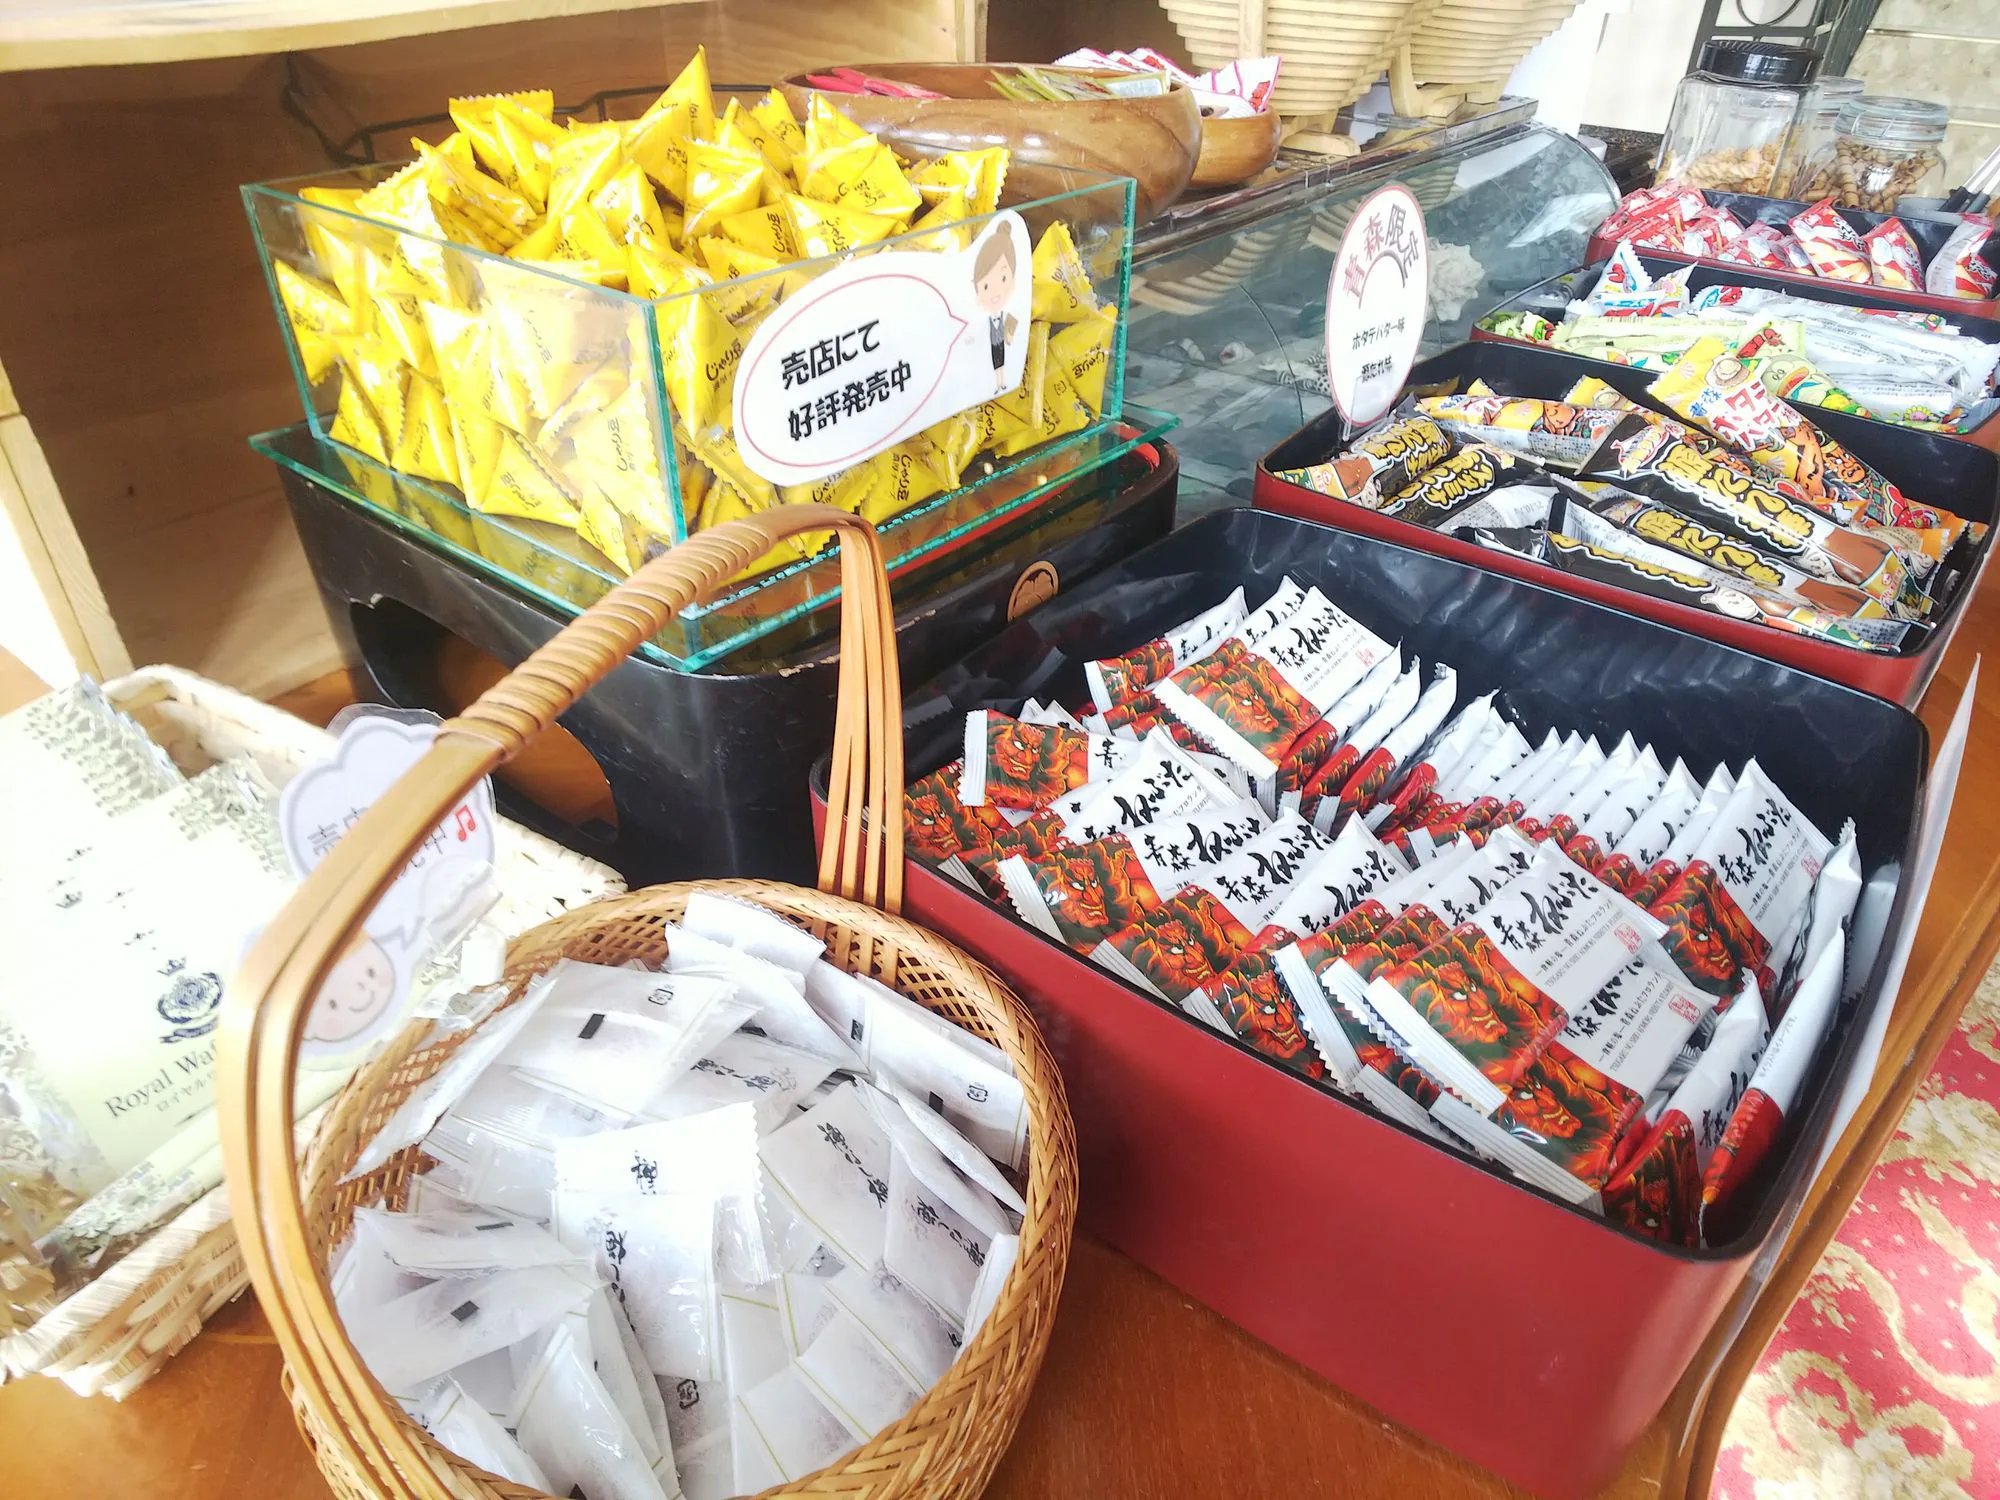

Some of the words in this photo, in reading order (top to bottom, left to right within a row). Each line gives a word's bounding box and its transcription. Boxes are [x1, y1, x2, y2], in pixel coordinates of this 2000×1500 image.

[1342, 204, 1420, 299] 青森限定
[705, 337, 743, 383] じゃり豆
[781, 319, 881, 390] 売店にて
[1352, 316, 1406, 350] ホタテバター味
[787, 360, 912, 442] 好評発売中
[896, 453, 913, 502] じゃり豆
[1269, 605, 1350, 670] 青森ねぶた
[1083, 760, 1193, 842] ねぶた
[1215, 824, 1332, 904] 青森ねぶた
[1717, 798, 1793, 886] 青森ねぶた
[1492, 870, 1601, 953] 青森ねぶた
[103, 1068, 174, 1118] Royal
